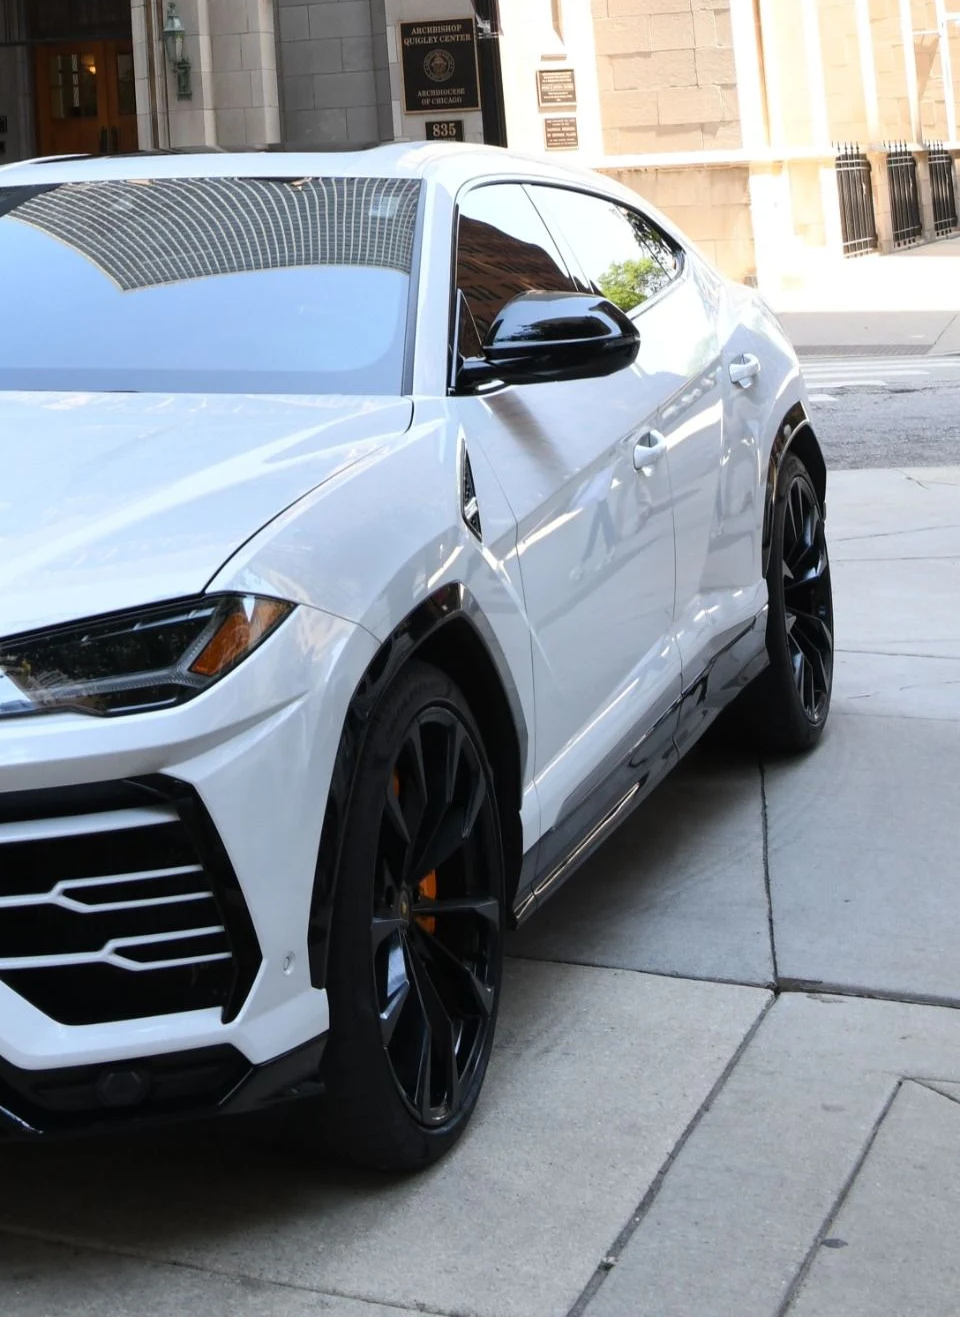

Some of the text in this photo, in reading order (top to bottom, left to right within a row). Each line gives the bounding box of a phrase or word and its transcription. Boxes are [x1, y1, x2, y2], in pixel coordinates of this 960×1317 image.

[411, 24, 462, 35] ARCHBISHOP
[403, 34, 471, 46] QUIGLEY CENTER
[417, 87, 465, 97] ARCHDIOCESE
[421, 96, 462, 105] OF CHICAGO
[432, 123, 456, 137] 835
